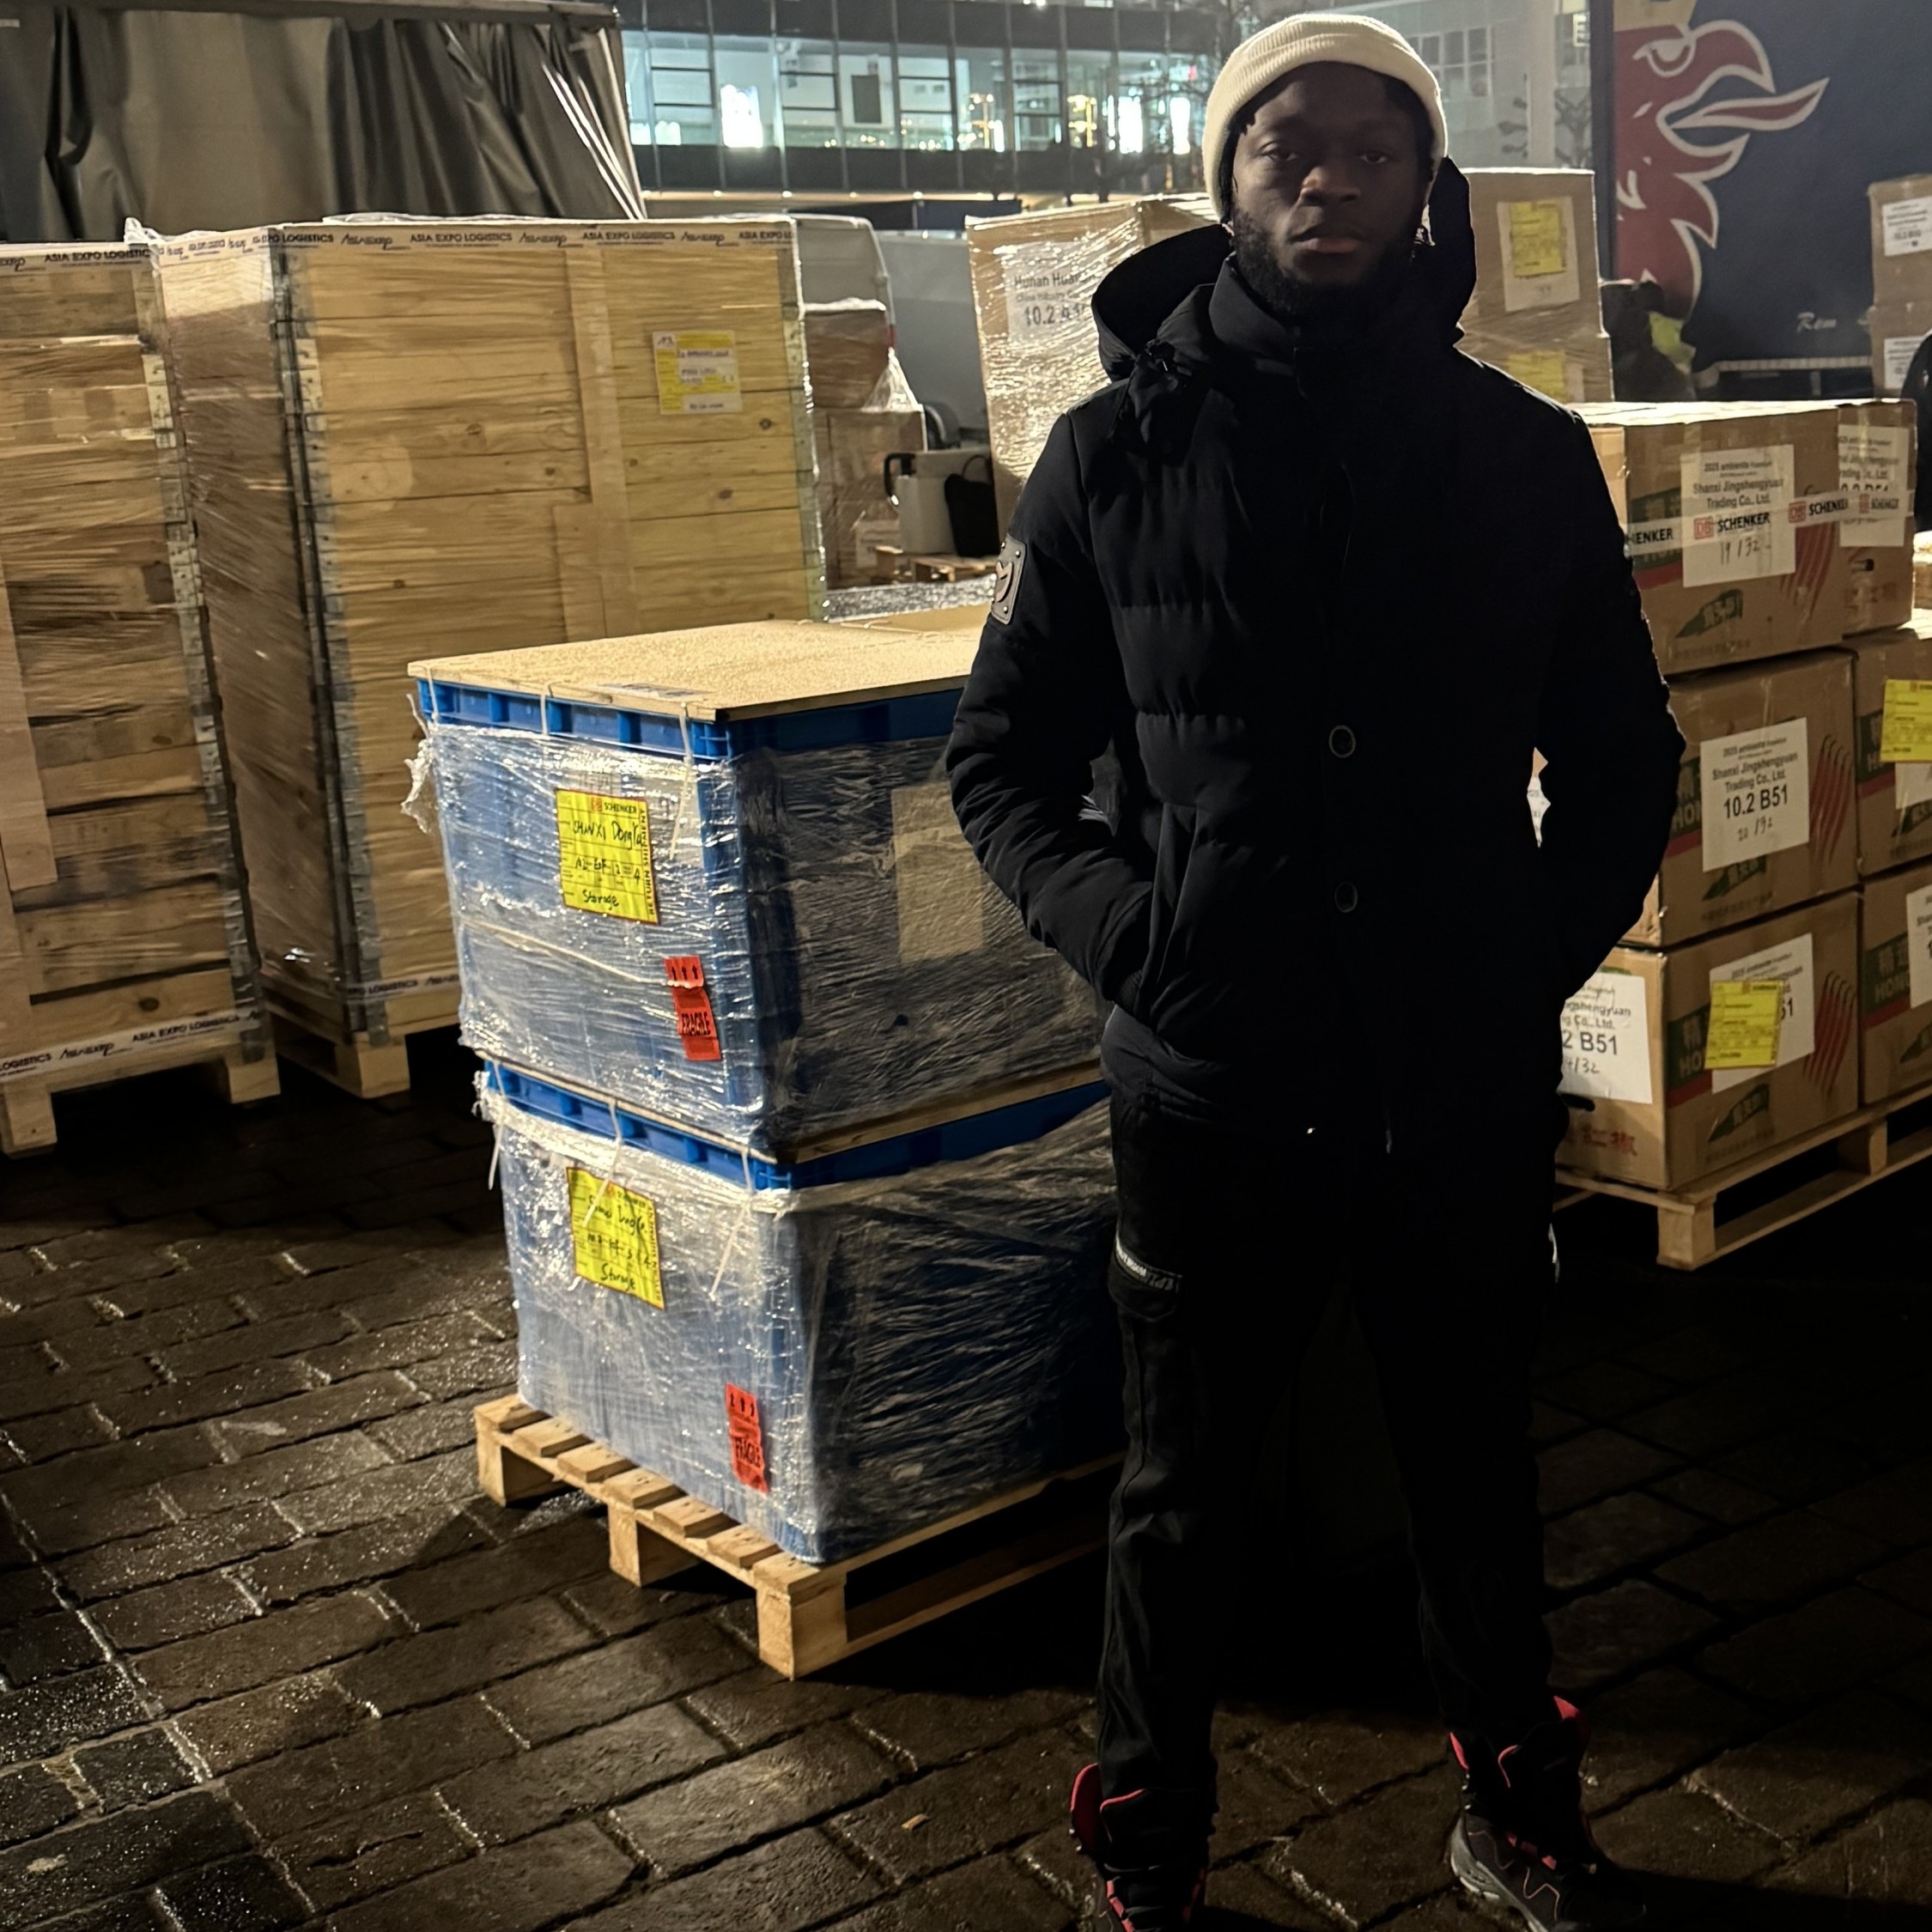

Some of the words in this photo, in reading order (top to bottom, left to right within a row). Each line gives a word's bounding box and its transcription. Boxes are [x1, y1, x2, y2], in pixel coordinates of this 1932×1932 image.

[282, 233, 334, 244] LOGISTICS
[434, 233, 462, 243] EXPO
[464, 232, 513, 242] LOGISTICS
[1716, 512, 1771, 533] SCHENKER
[604, 801, 637, 813] SCHENKER
[1722, 792, 1755, 819] 10.2
[1760, 783, 1789, 811] B51
[582, 889, 620, 911] Storage
[682, 1011, 712, 1037] FRAGILE
[1580, 1031, 1619, 1056] B51
[0, 1053, 52, 1072] OGISTICS
